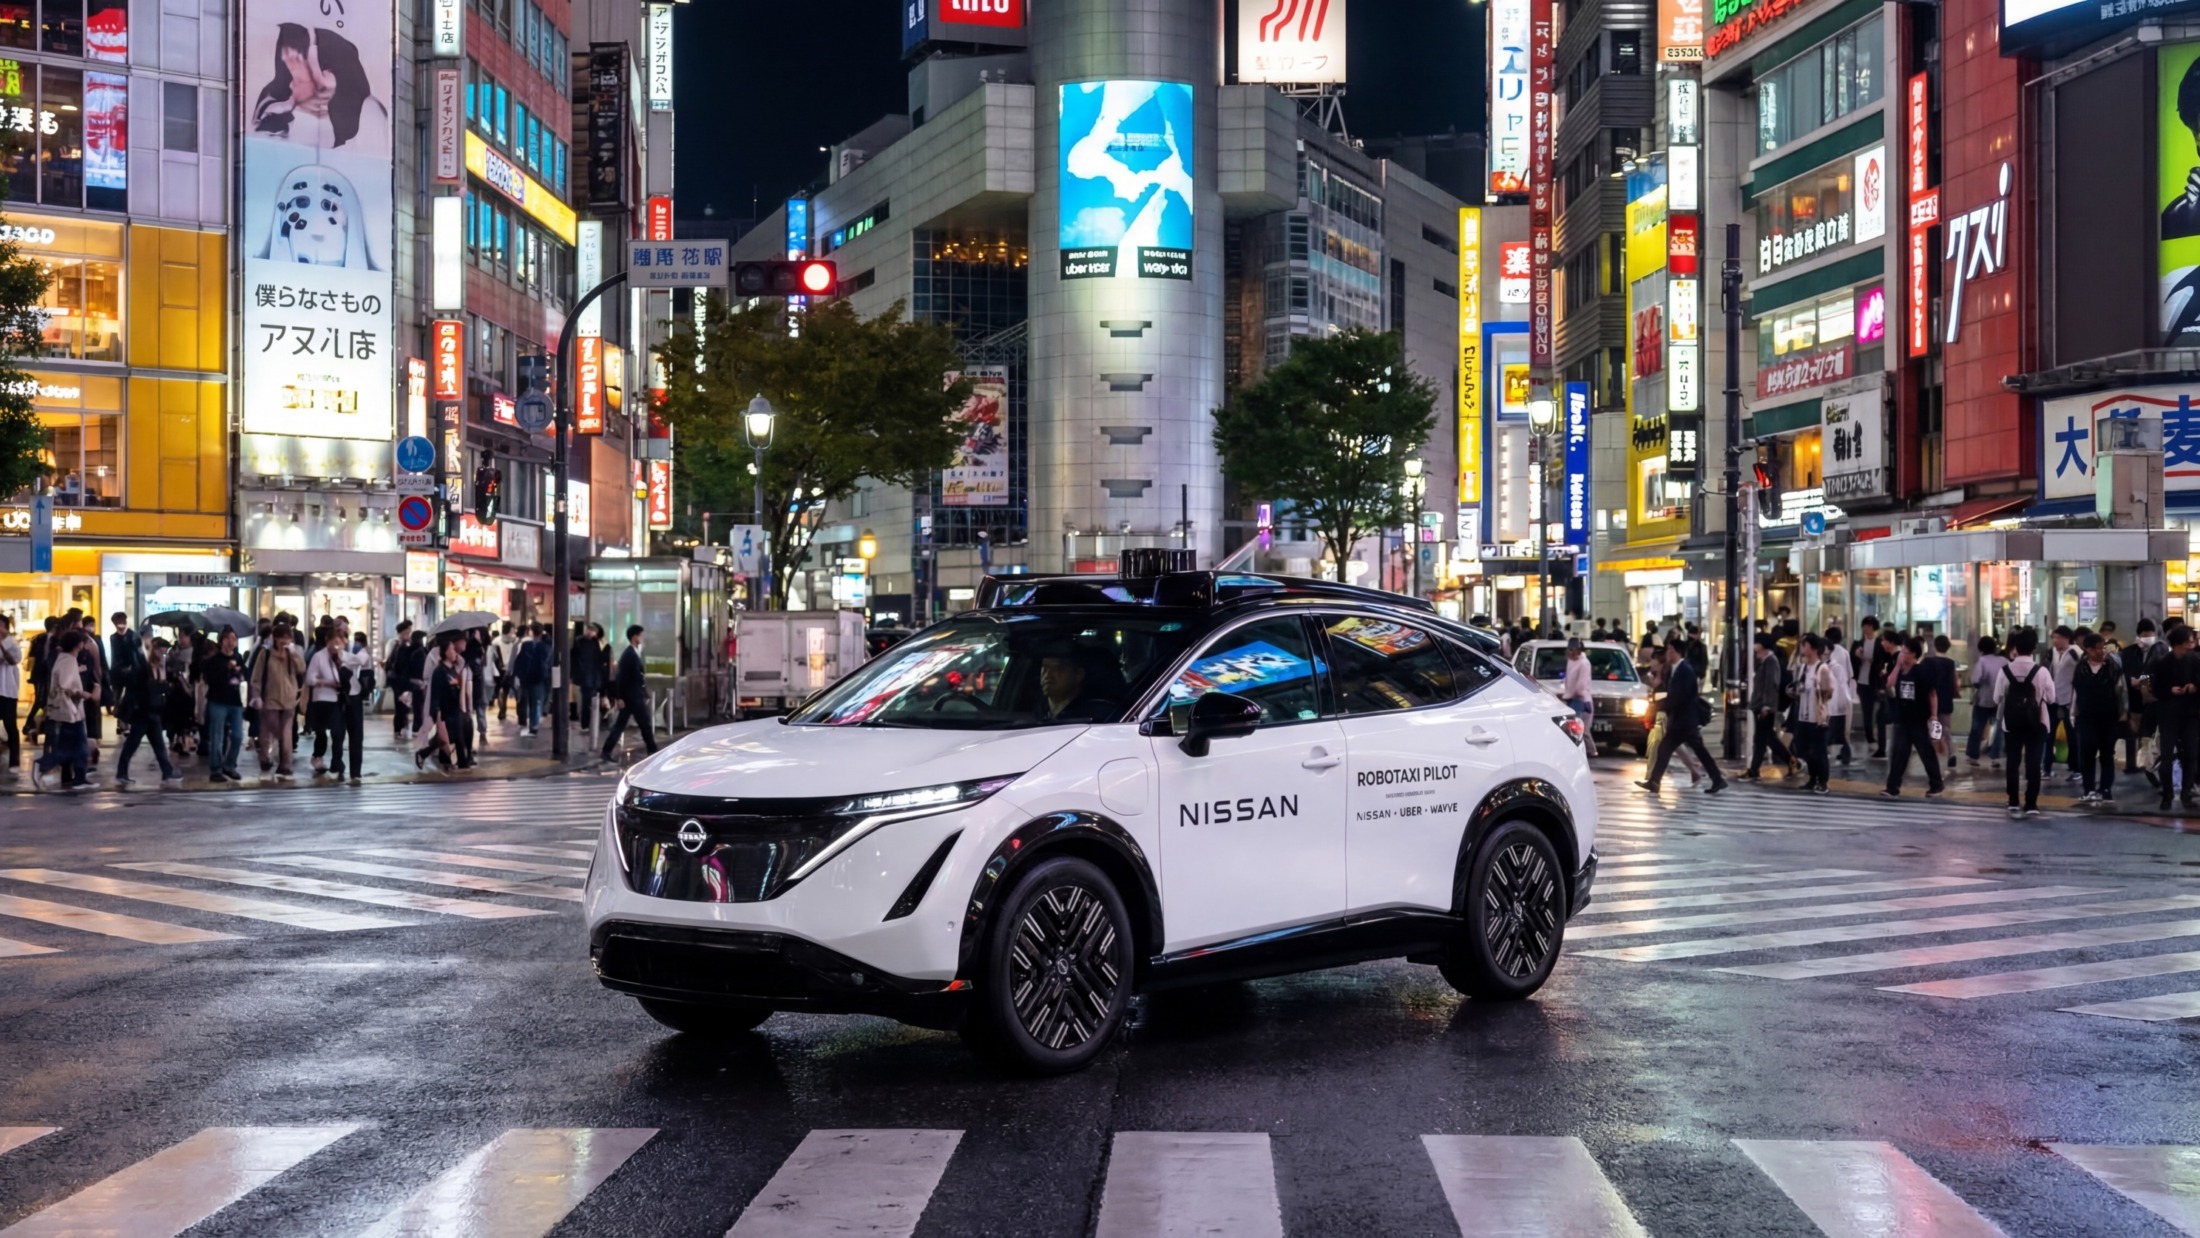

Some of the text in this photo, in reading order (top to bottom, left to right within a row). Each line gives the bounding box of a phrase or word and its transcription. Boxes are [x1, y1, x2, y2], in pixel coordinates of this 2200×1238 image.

[255, 284, 381, 315] 僕らなさもの
[2055, 394, 2200, 479] 大麦
[1357, 765, 1458, 787] ROBOTAXI PILOT
[1179, 794, 1299, 827] NISSAN
[1356, 809, 1391, 822] NISSAN
[1399, 806, 1423, 818] UBER
